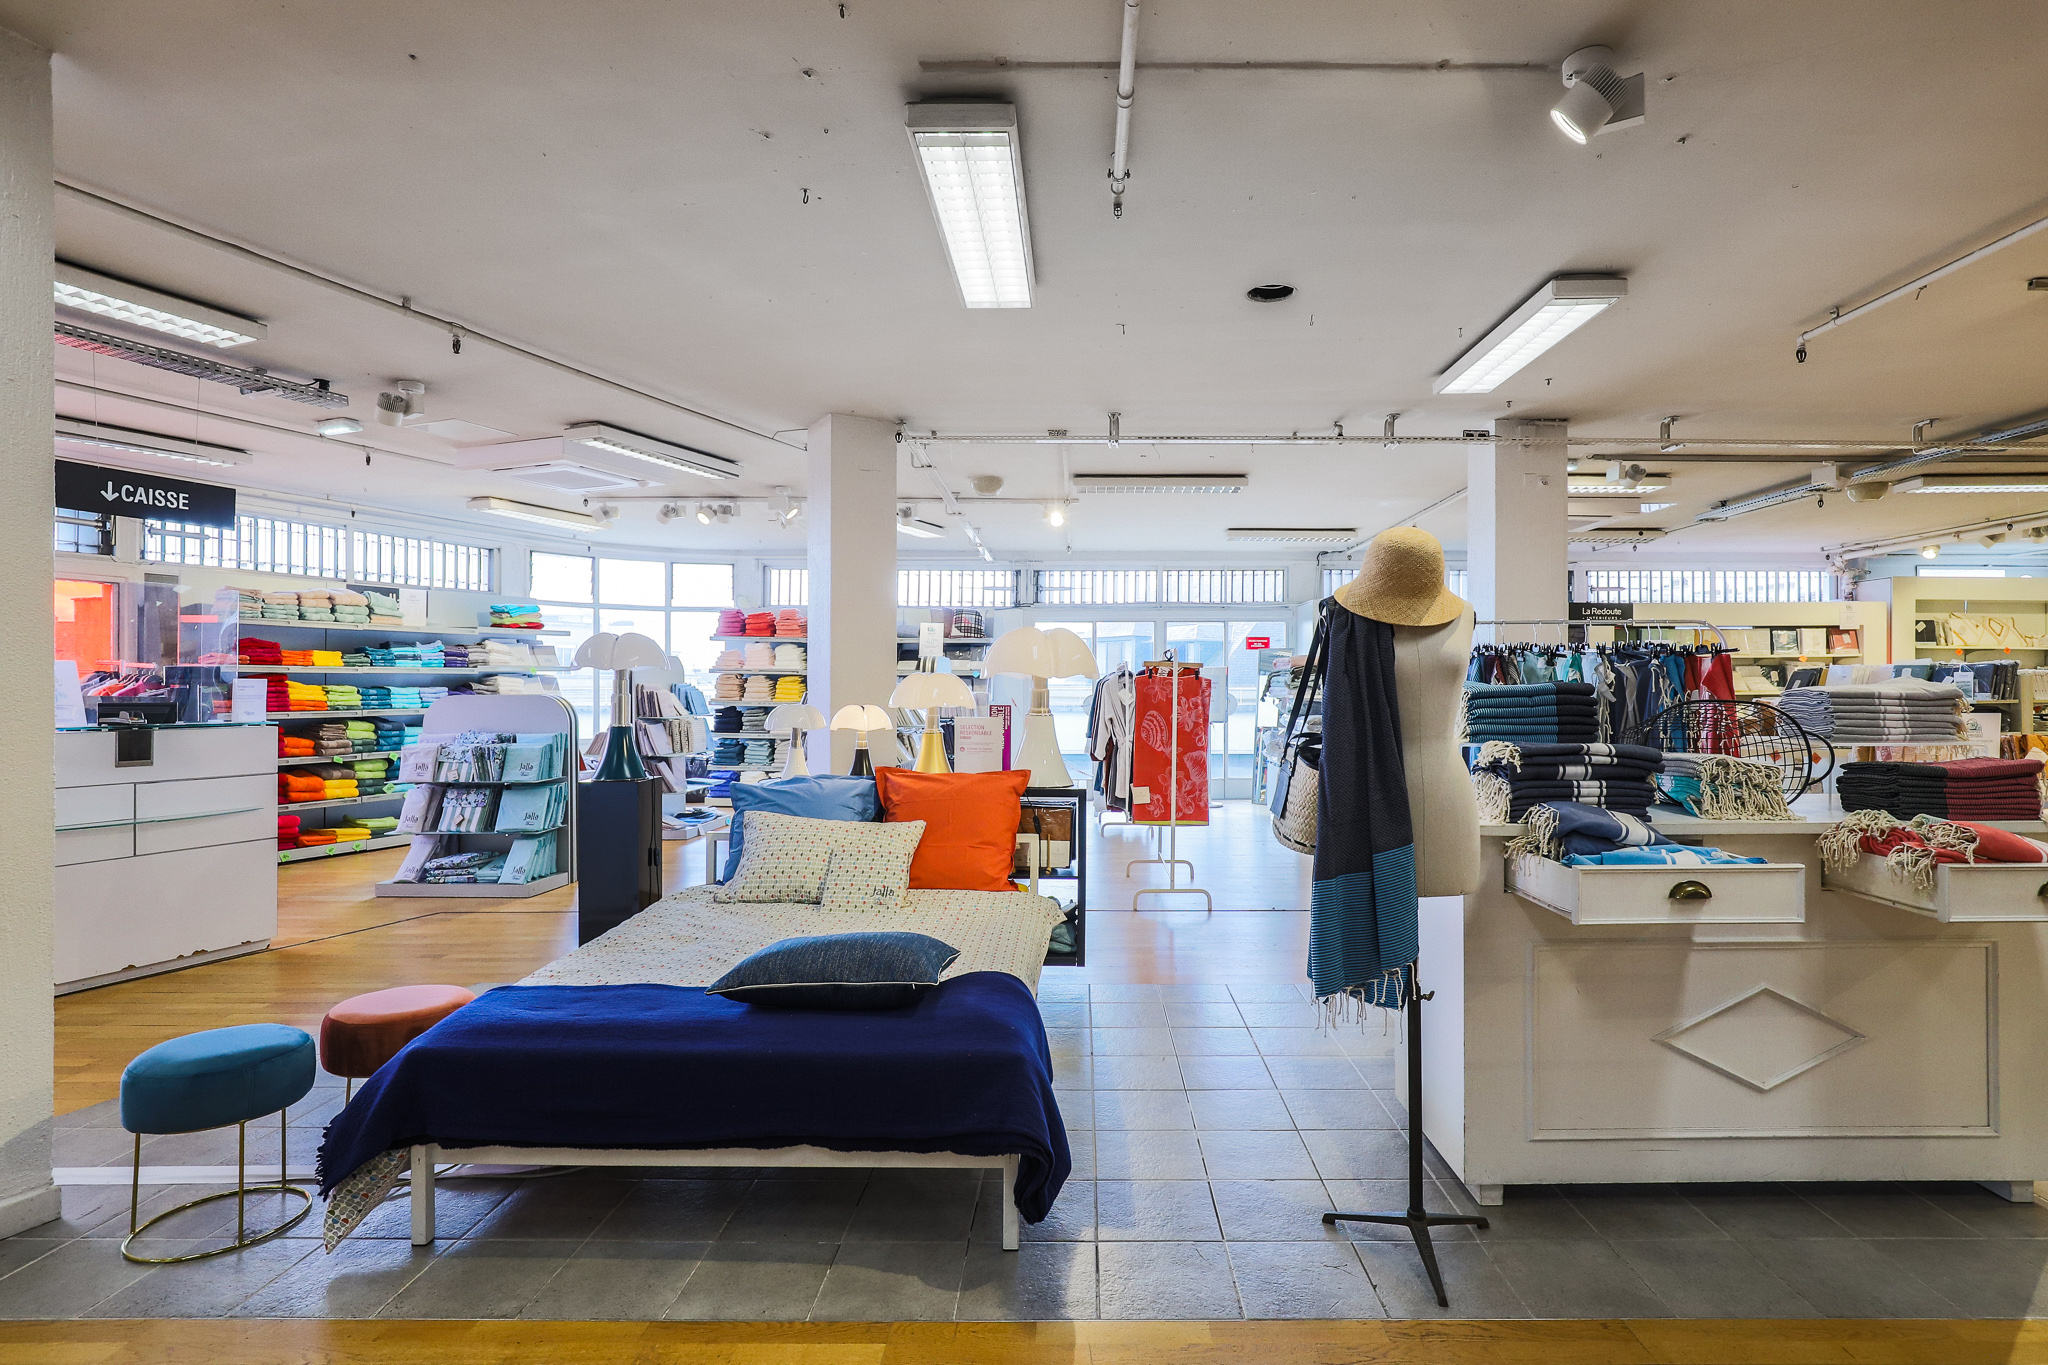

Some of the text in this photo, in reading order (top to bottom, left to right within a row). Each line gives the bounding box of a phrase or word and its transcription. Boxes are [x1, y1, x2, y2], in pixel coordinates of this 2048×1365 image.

[121, 484, 190, 510] CAISSE
[1582, 607, 1622, 616] La Redoute
